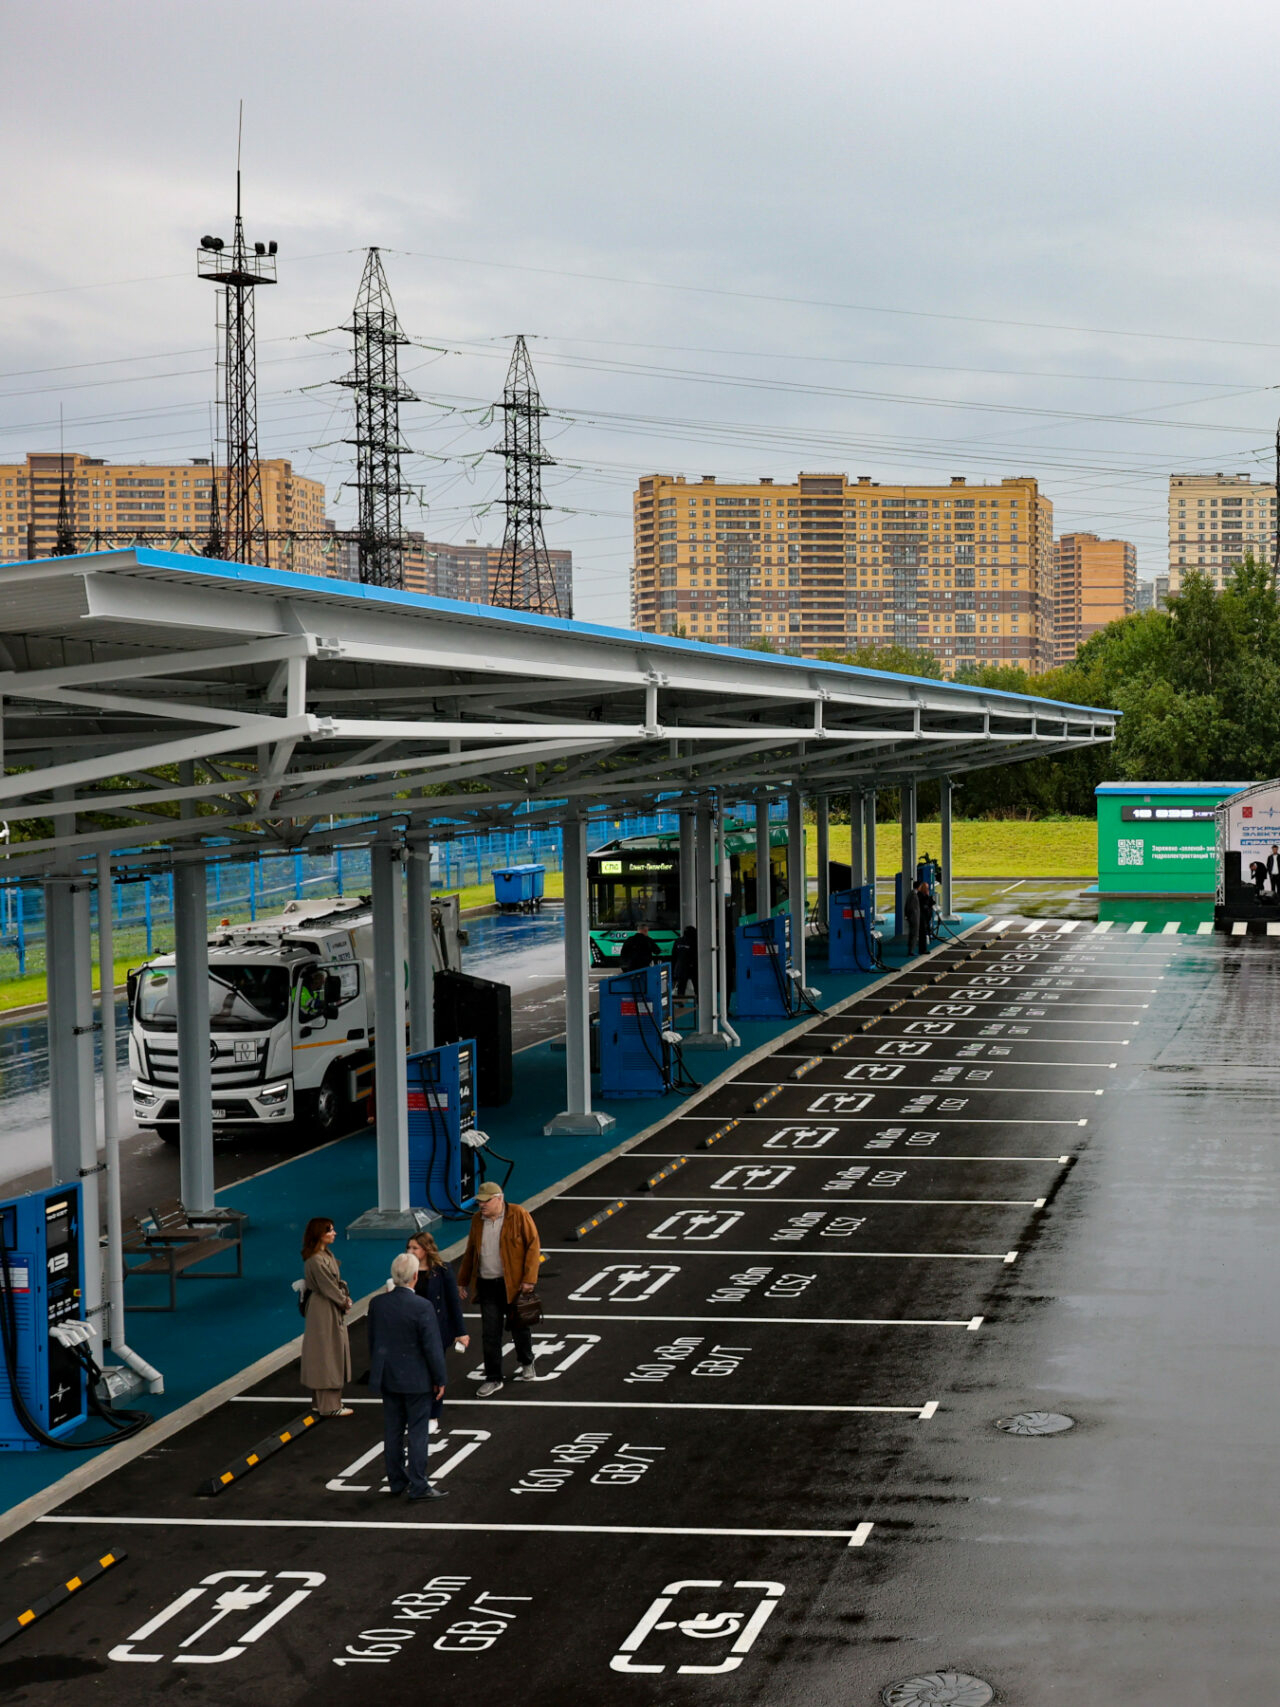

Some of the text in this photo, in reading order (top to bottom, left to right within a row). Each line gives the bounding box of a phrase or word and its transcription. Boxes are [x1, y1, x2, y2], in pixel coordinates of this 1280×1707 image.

[769, 1228, 809, 1241] 160
[820, 1216, 867, 1237] CCS2
[47, 1252, 69, 1274] 13
[706, 1288, 751, 1303] 160
[763, 1273, 818, 1298] CCS2
[623, 1363, 676, 1384] 160
[690, 1345, 753, 1377] GB/T
[590, 1443, 666, 1485] GB/T
[510, 1468, 575, 1495] 160
[433, 1591, 533, 1652] GB/T
[332, 1629, 416, 1667] 160
